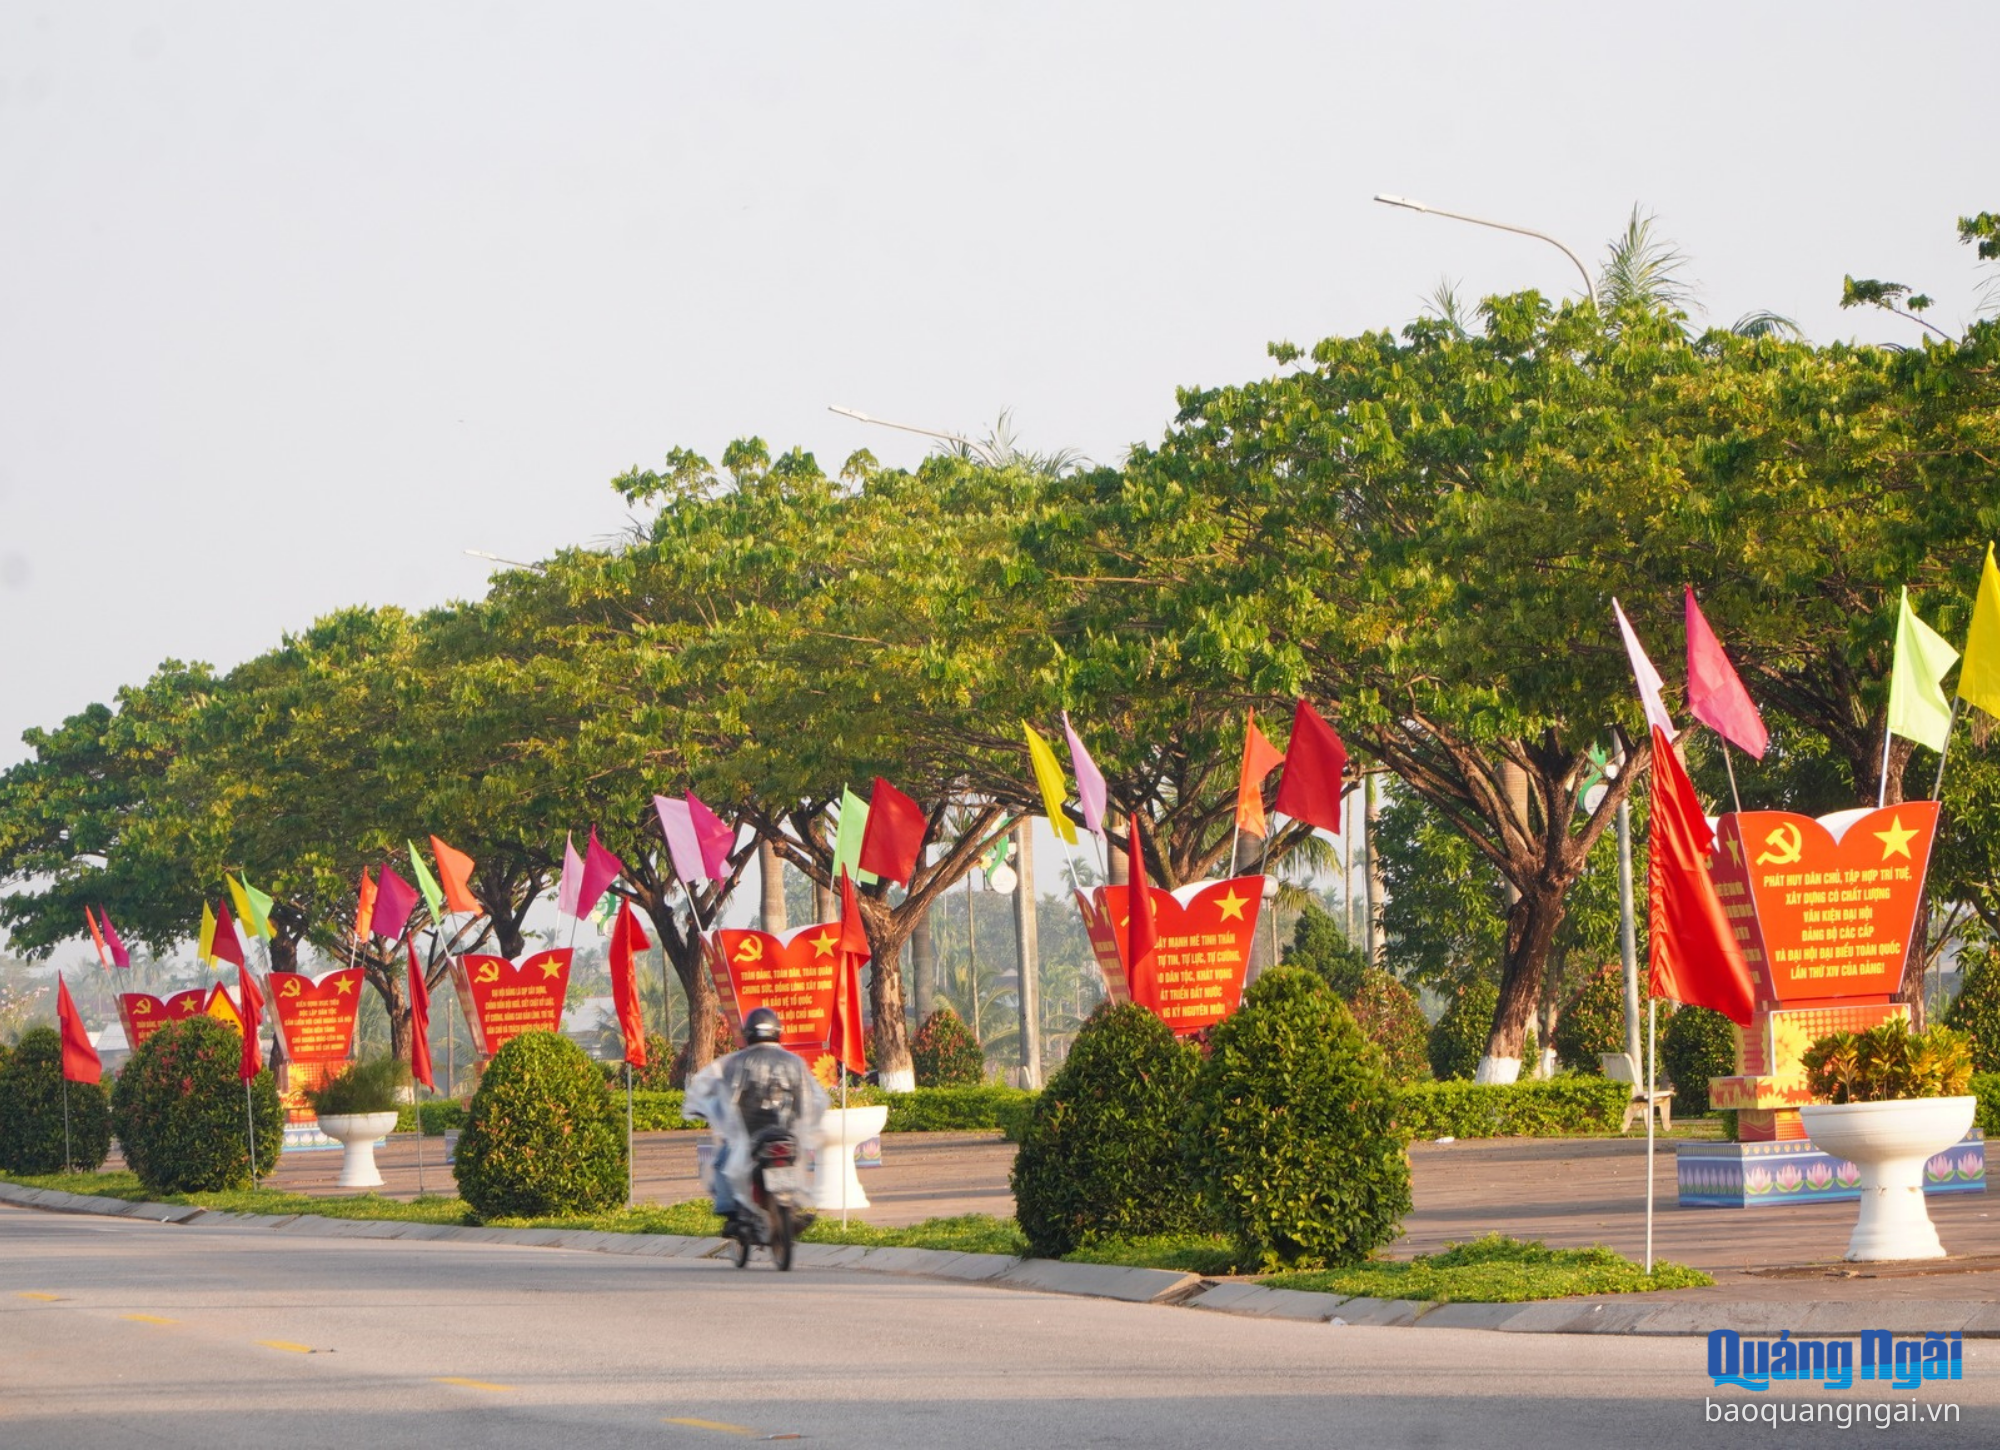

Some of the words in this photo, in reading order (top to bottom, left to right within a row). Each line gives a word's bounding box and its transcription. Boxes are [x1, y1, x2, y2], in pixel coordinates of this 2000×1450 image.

[1764, 873, 1785, 887] PHÁT
[1786, 874, 1803, 887] HUY
[1805, 871, 1822, 886] DÂN
[1824, 869, 1843, 885] CHỦ,
[1844, 869, 1860, 885] TẬP
[1862, 869, 1878, 884] HỢP
[1881, 866, 1893, 881] TRÍ
[1895, 866, 1912, 881] TUỆ,
[1786, 891, 1803, 905] XÂY
[1804, 891, 1826, 906] DỰNG
[1828, 889, 1839, 903] CÓ
[1842, 886, 1862, 902] CHẤT
[1864, 887, 1891, 902] LƯỢNG
[1803, 909, 1821, 923] VĂN
[1822, 908, 1841, 924] KIỆN
[1843, 908, 1857, 922] ĐẠI
[1859, 905, 1873, 921] HỘI
[1802, 926, 1825, 941] ĐẢNG
[1826, 926, 1838, 942] BỘ
[1840, 925, 1856, 939] CÁC
[1858, 923, 1874, 938] CẤP
[1154, 936, 1166, 951] ẬY
[1775, 948, 1786, 962] VÀ
[1788, 949, 1802, 963] ĐẠI
[1804, 946, 1818, 962] HỘI
[1820, 947, 1834, 961] ĐẠI
[1835, 942, 1854, 958] BIỂU
[1856, 942, 1877, 957] TOÀN
[1879, 939, 1901, 956] QUỐC
[1809, 964, 1825, 979] THỨ
[1826, 965, 1840, 978] XIV
[1842, 961, 1858, 977] CỦA
[1860, 960, 1885, 975] ĐẢNG!
